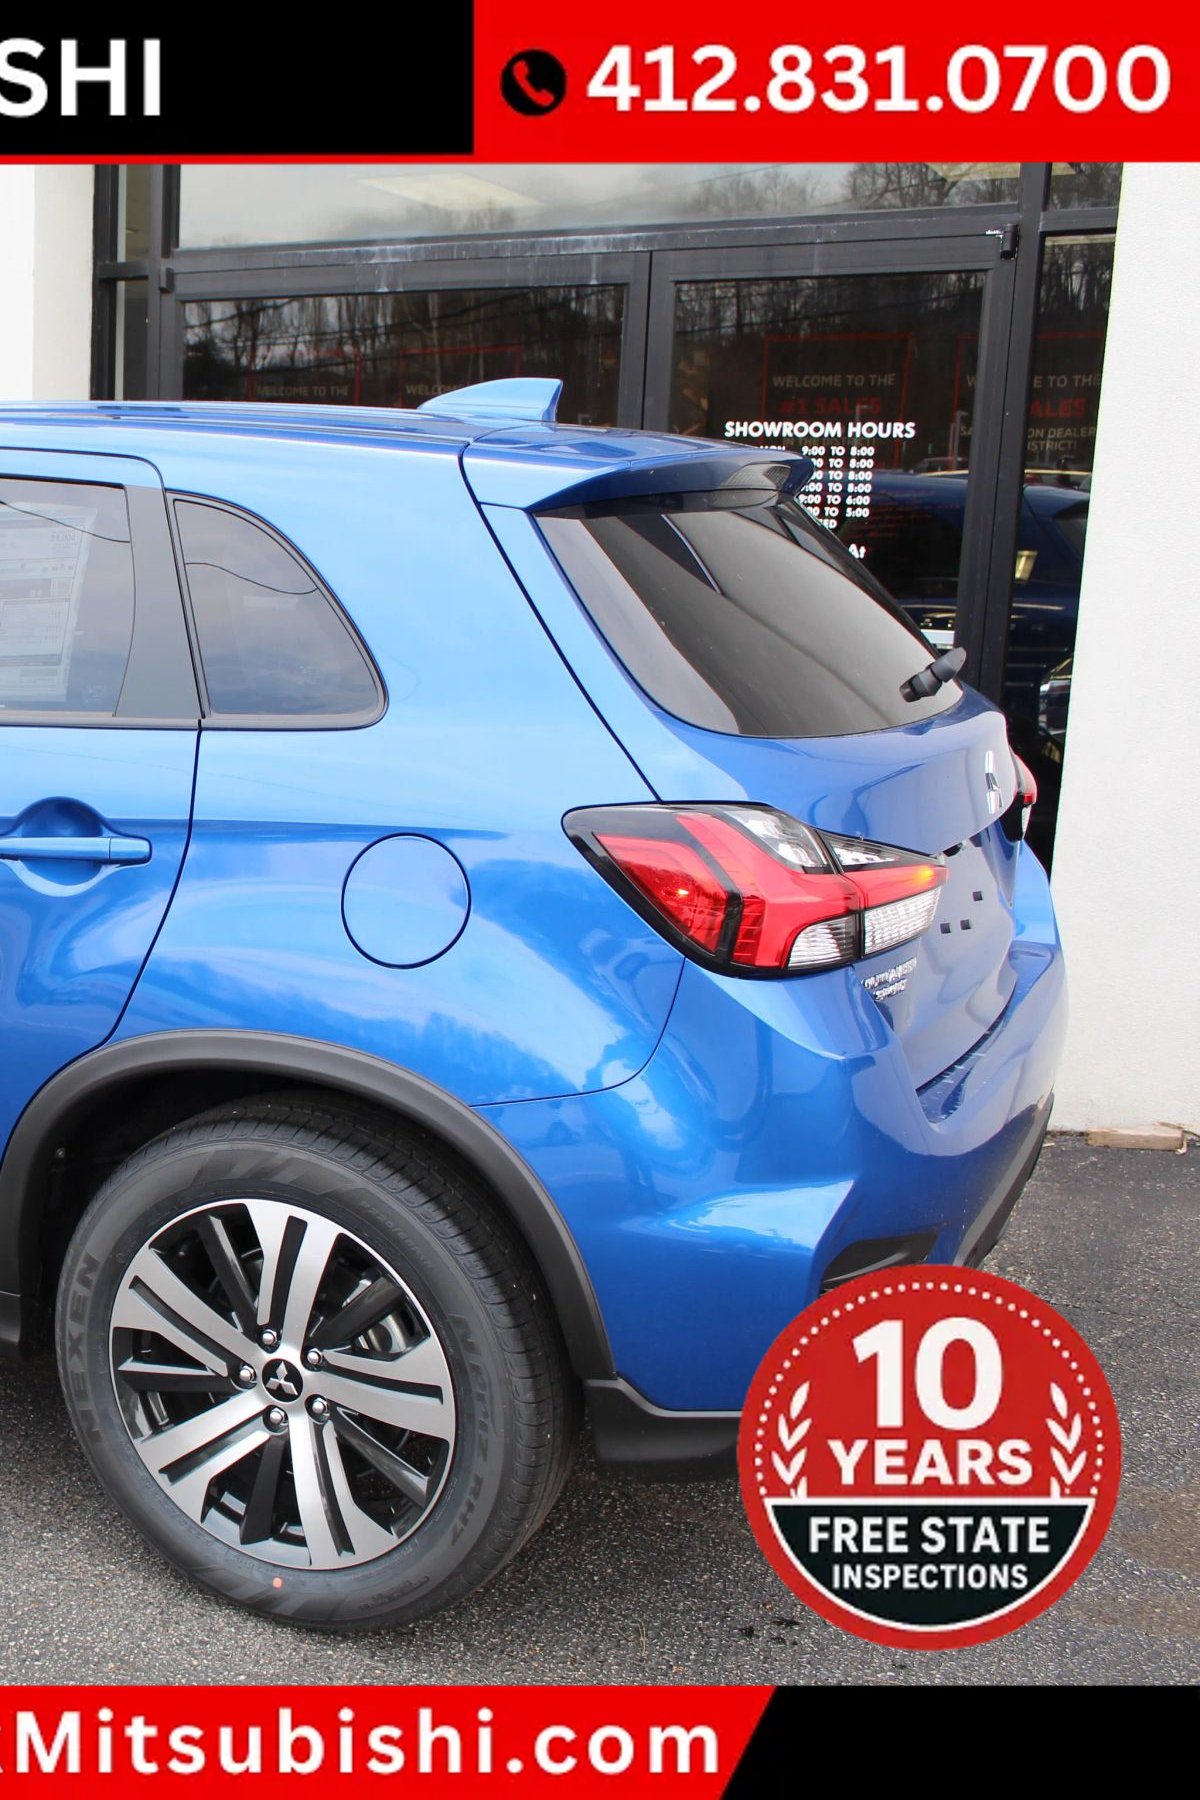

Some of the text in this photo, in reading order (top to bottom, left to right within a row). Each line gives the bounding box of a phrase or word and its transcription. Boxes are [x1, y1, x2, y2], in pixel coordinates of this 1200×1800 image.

[772, 373, 896, 388] WELCOME TO THE
[1048, 375, 1067, 388] TO
[1029, 397, 1087, 417] ALES
[724, 421, 916, 439] SHOWROOM HOURS
[801, 446, 875, 456] 9:00 TO 8:00
[828, 458, 844, 469] TO
[849, 458, 875, 469] 8:00
[828, 470, 843, 480] TO
[848, 470, 872, 481] 8:00
[827, 482, 842, 492] TO
[847, 483, 872, 493] 8:00
[825, 494, 841, 504] TO
[845, 495, 871, 505] 6:00
[824, 506, 839, 517] TO
[845, 507, 870, 518] 5:00
[65, 1250, 104, 1444] NEXEN
